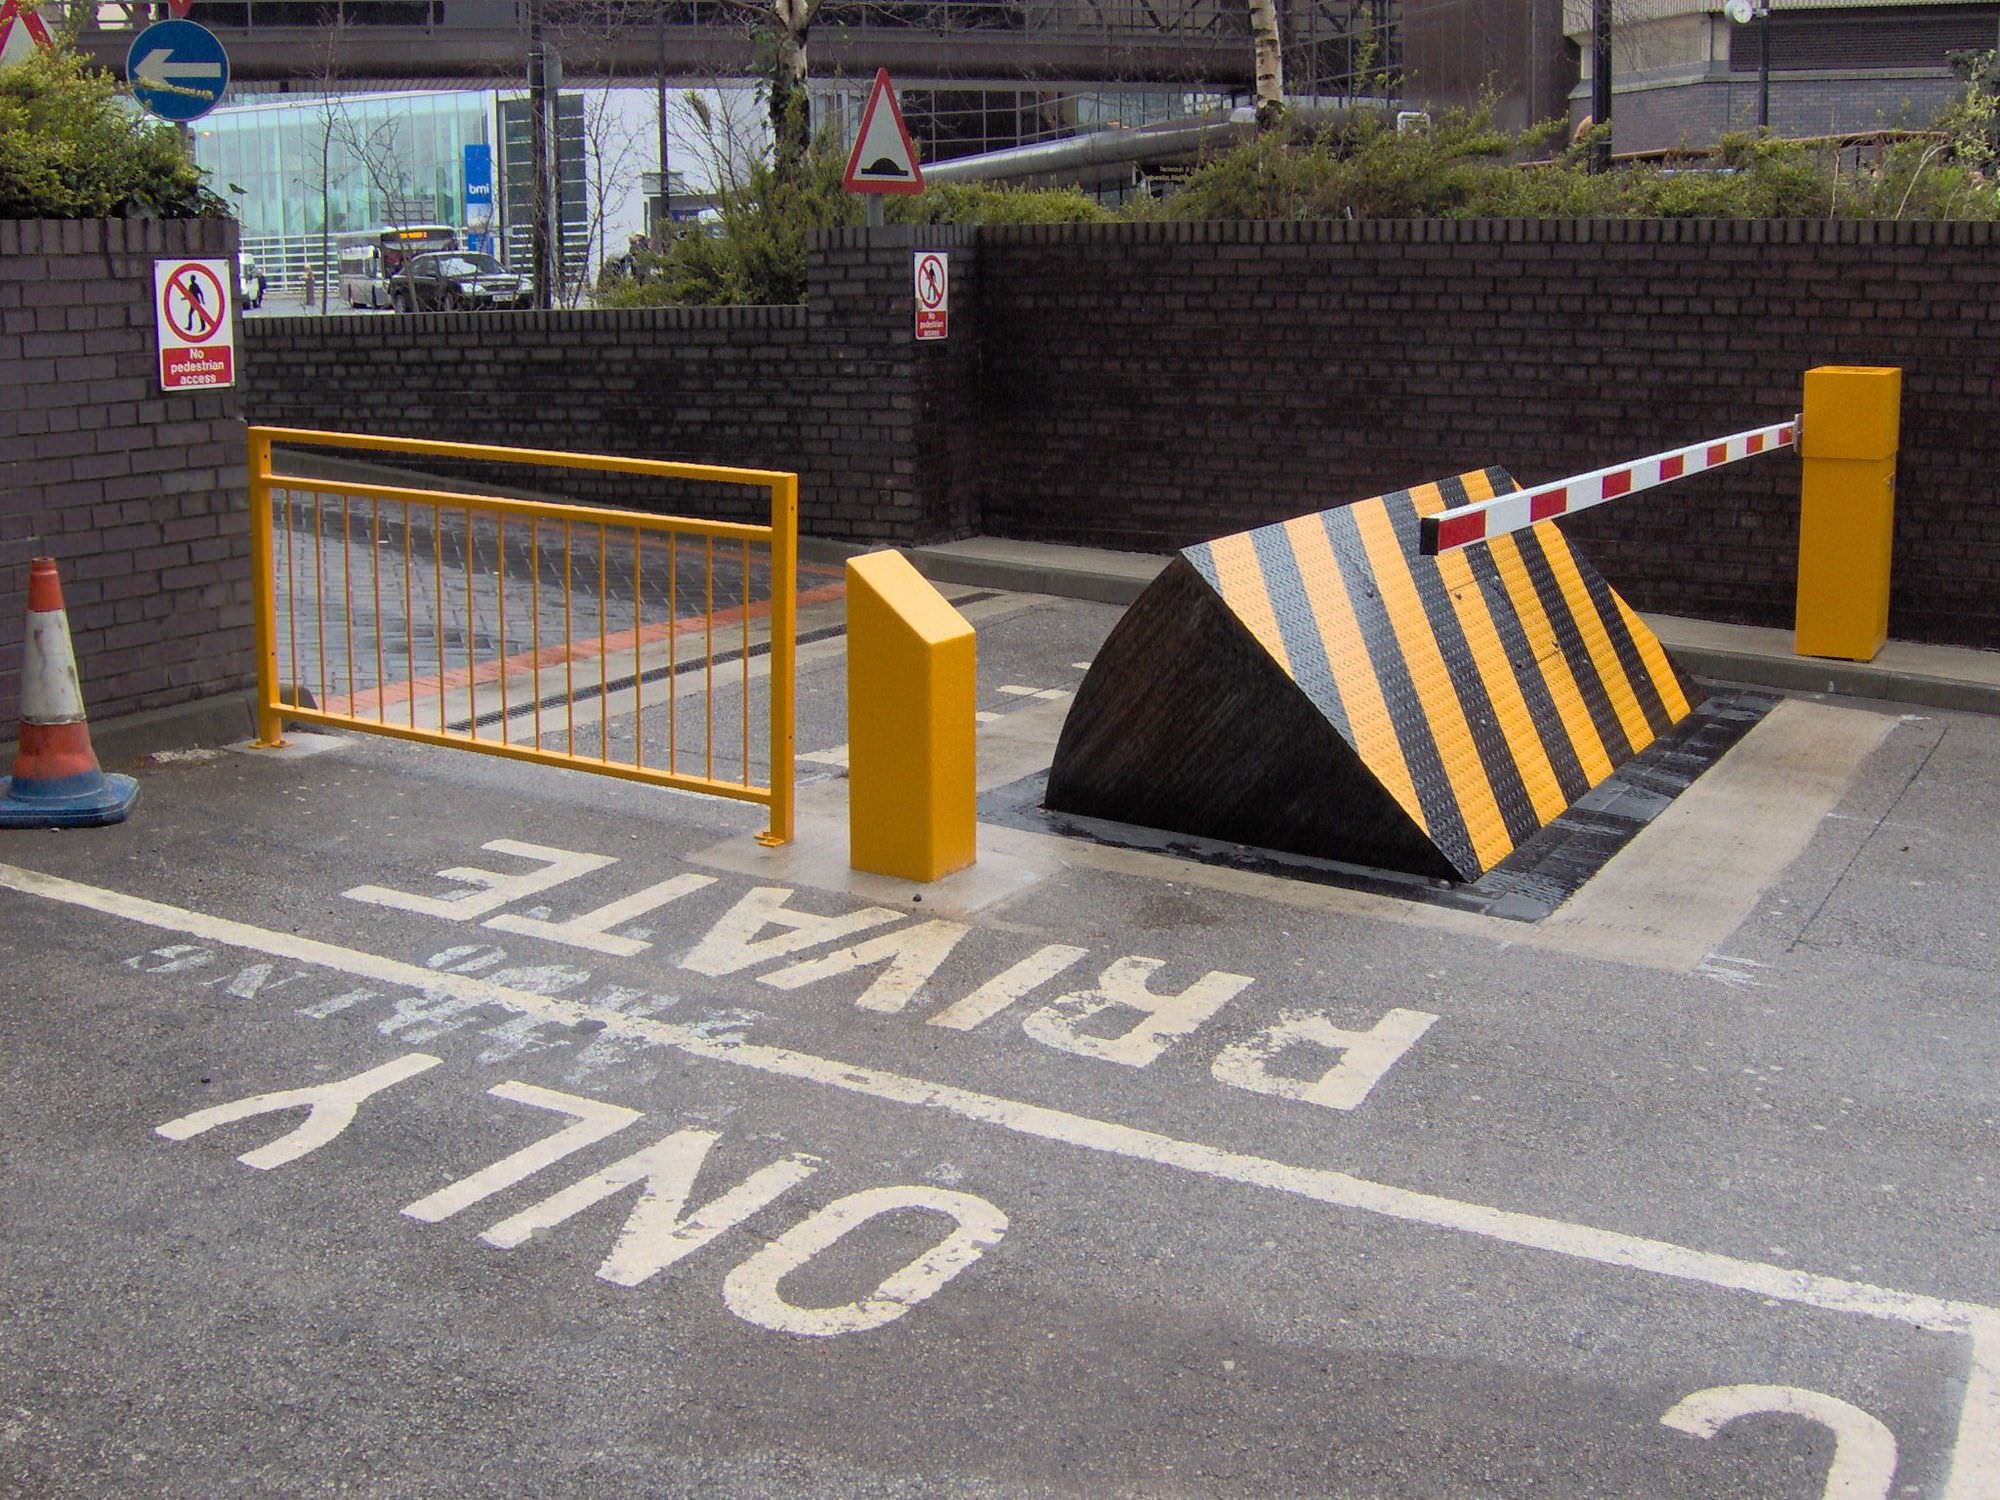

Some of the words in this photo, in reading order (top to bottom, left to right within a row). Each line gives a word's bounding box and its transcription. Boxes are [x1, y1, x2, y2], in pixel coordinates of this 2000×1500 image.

[468, 183, 490, 196] bmi
[190, 349, 204, 359] No
[171, 361, 224, 375] pedestrian
[181, 375, 216, 385] access
[340, 839, 1441, 1111] PRIVATE
[155, 1052, 1010, 1335] ONLY
